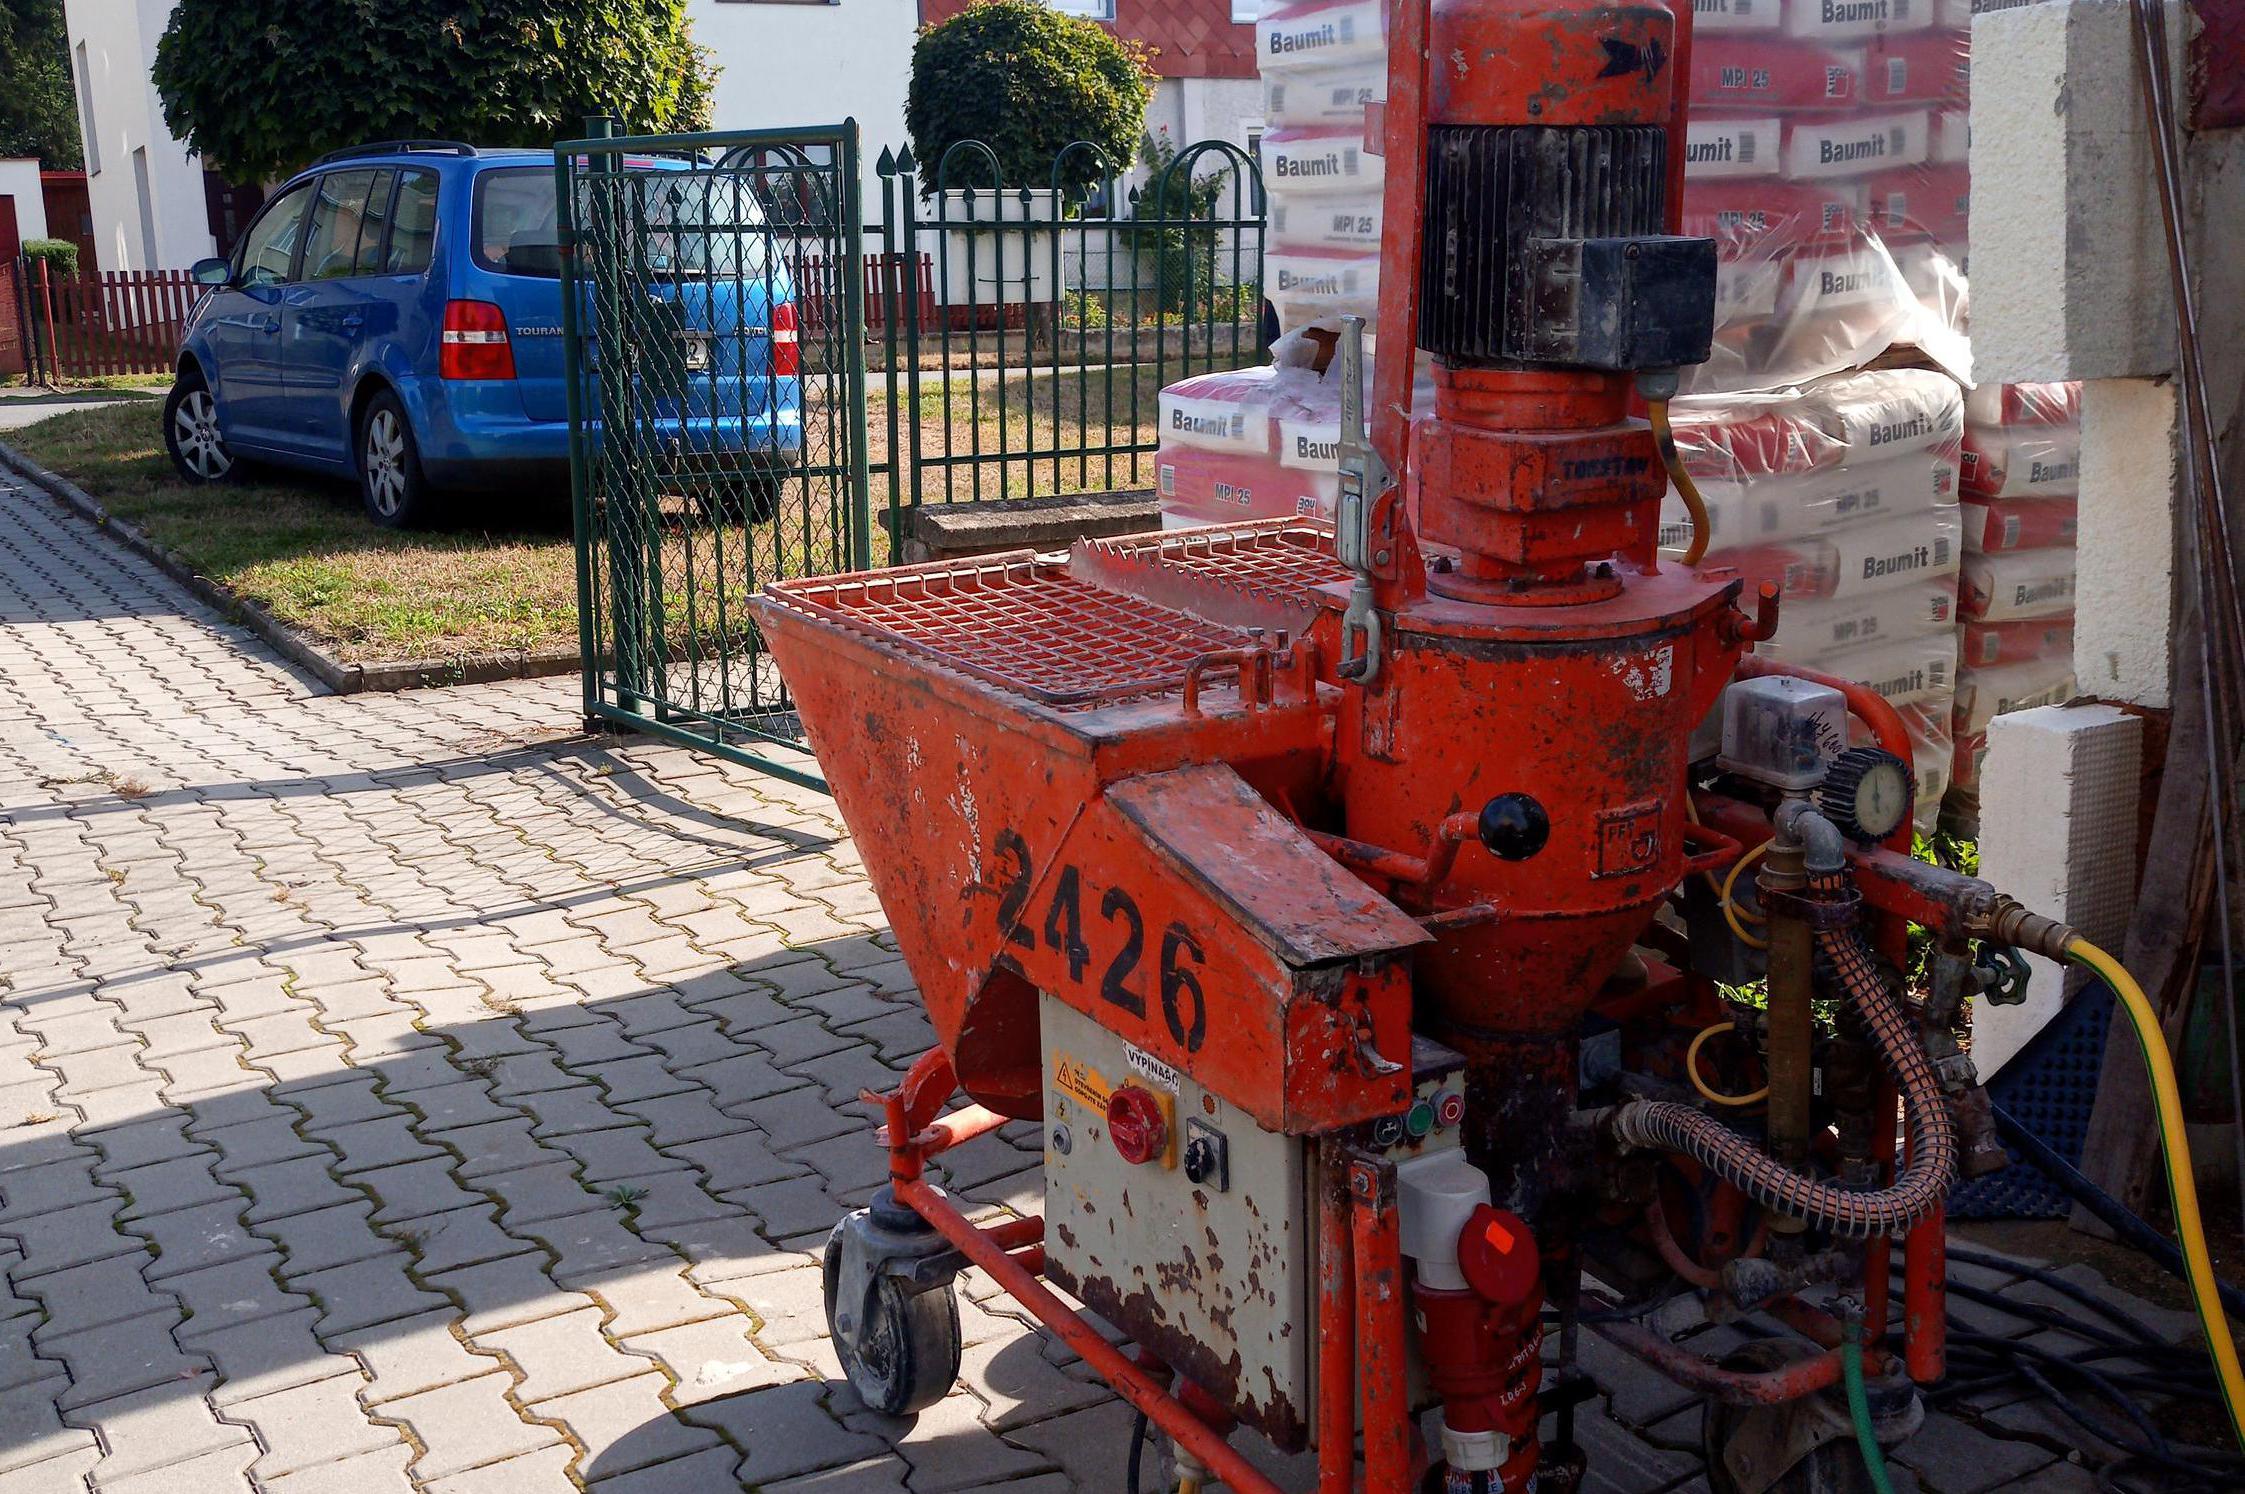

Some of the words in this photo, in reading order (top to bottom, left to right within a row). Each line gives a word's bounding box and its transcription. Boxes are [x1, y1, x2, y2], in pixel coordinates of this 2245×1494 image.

[1822, 0, 1887, 23] Baumit
[1270, 24, 1335, 54] Baumit
[1721, 67, 1747, 88] MPI
[1752, 69, 1769, 87] 25
[1358, 87, 1373, 105] 25
[1687, 137, 1732, 162] umit
[1820, 133, 1885, 164] Baumit
[1275, 153, 1339, 177] Baumit
[1333, 215, 1355, 232] MPI
[1358, 216, 1373, 233] 25
[1278, 269, 1339, 295] Baumit
[515, 326, 564, 337] TOURAN
[1172, 408, 1228, 437] Baumit
[1215, 483, 1234, 501] MPI
[1237, 486, 1251, 505] 25
[1863, 546, 1929, 579] Baumit
[1833, 621, 1858, 642] MPI
[1861, 616, 1878, 634] 25
[994, 827, 1206, 1054] 2426
